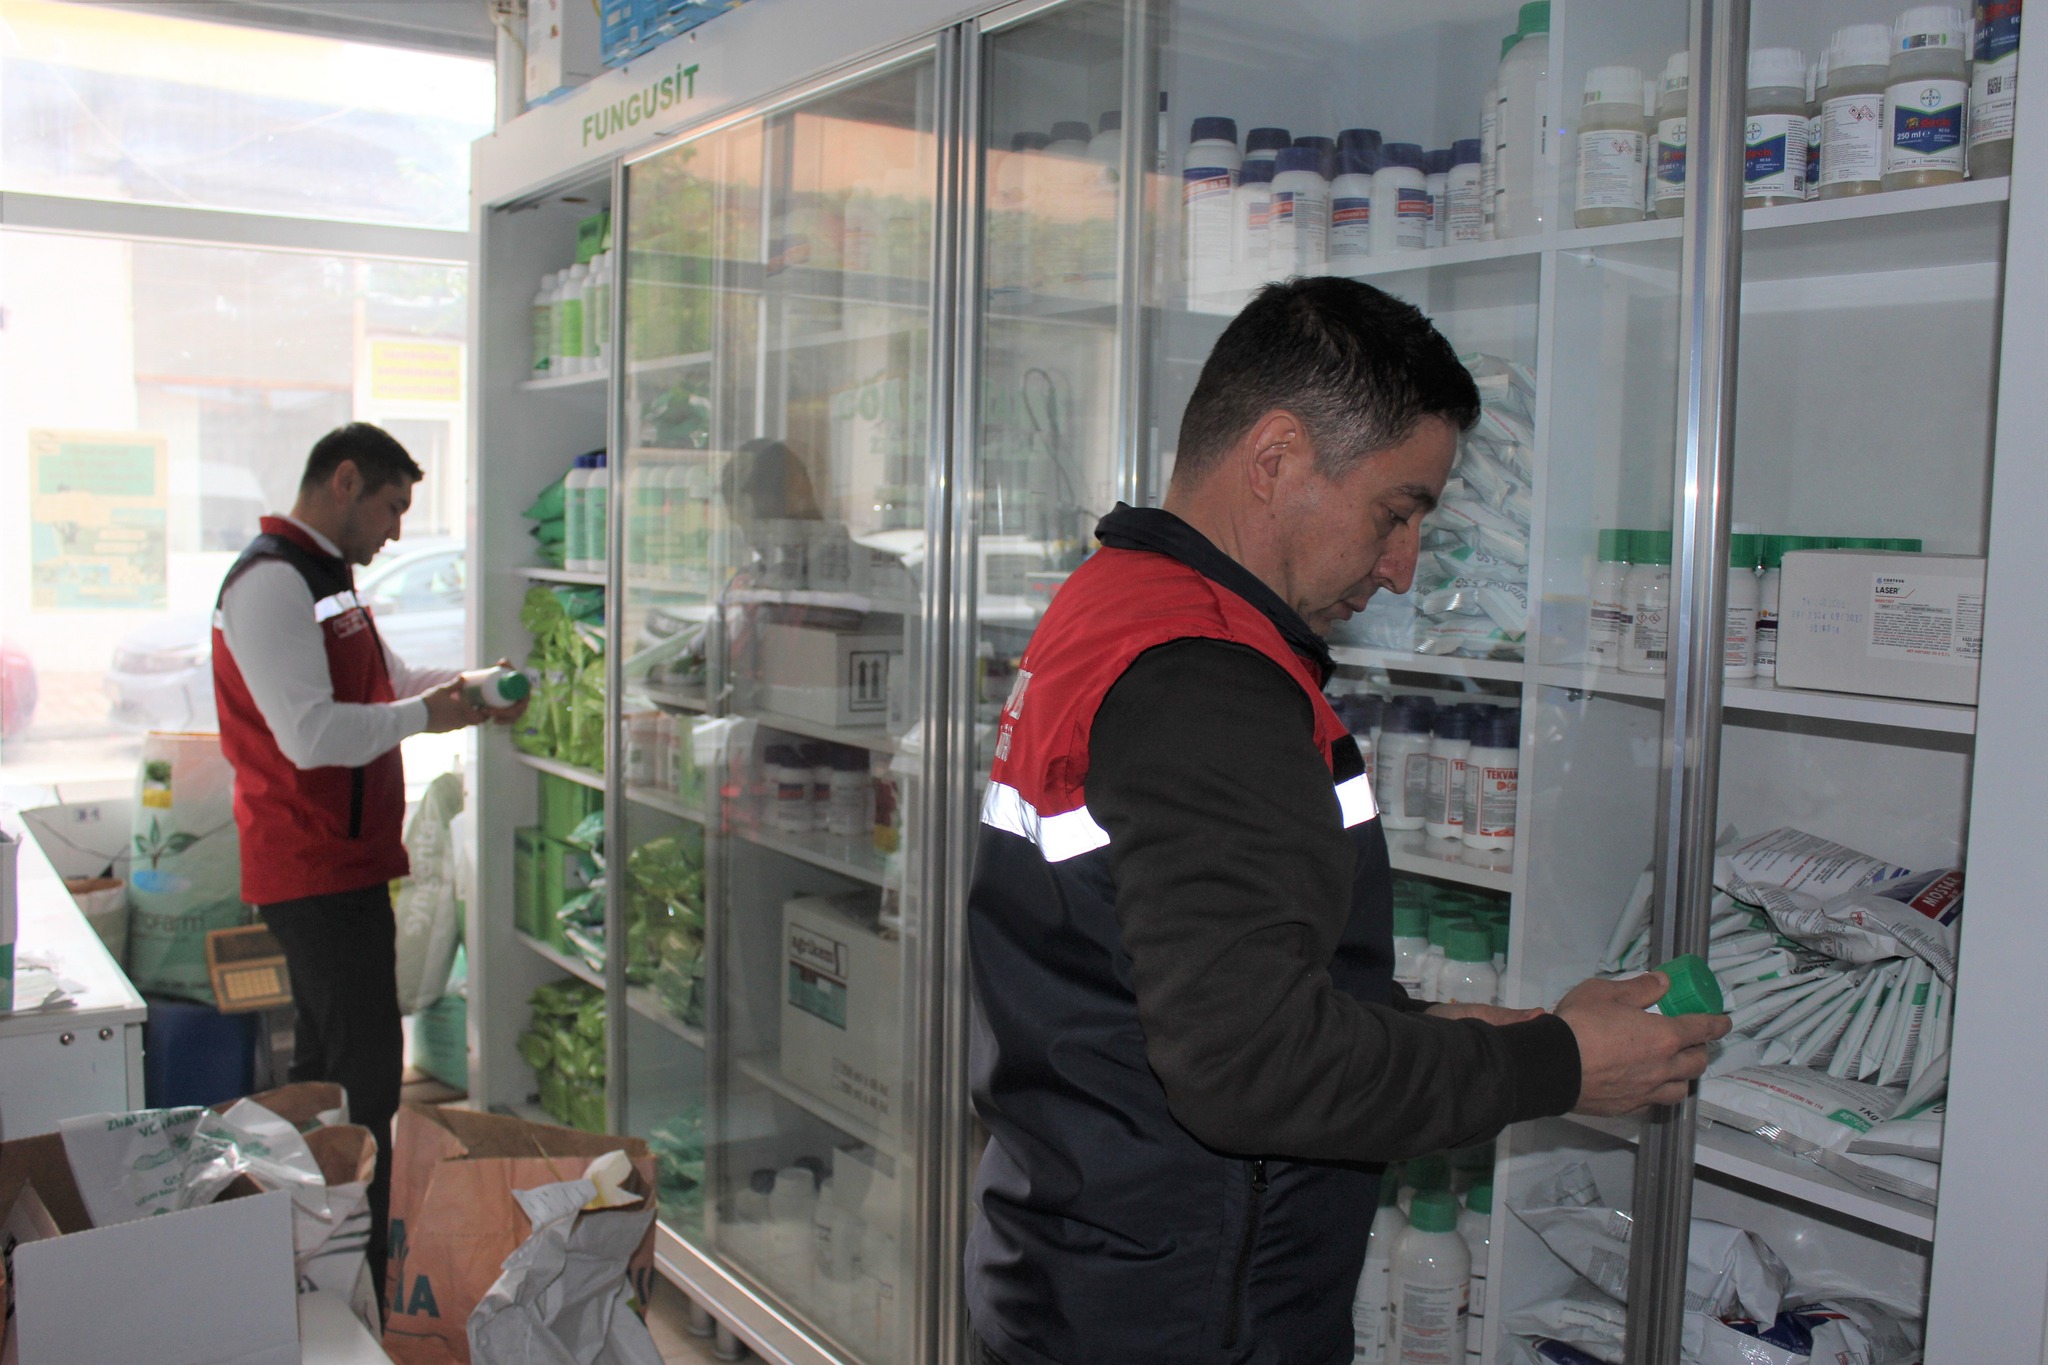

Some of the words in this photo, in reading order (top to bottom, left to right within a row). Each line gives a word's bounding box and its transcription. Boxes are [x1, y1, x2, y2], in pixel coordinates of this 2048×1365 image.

[582, 63, 700, 148] FUNGUSİT
[1896, 132, 1910, 141] 250
[1911, 131, 1921, 139] ml
[1875, 586, 1898, 595] LASER
[405, 819, 440, 936] syngenta
[1922, 876, 1962, 908] MOSTAR
